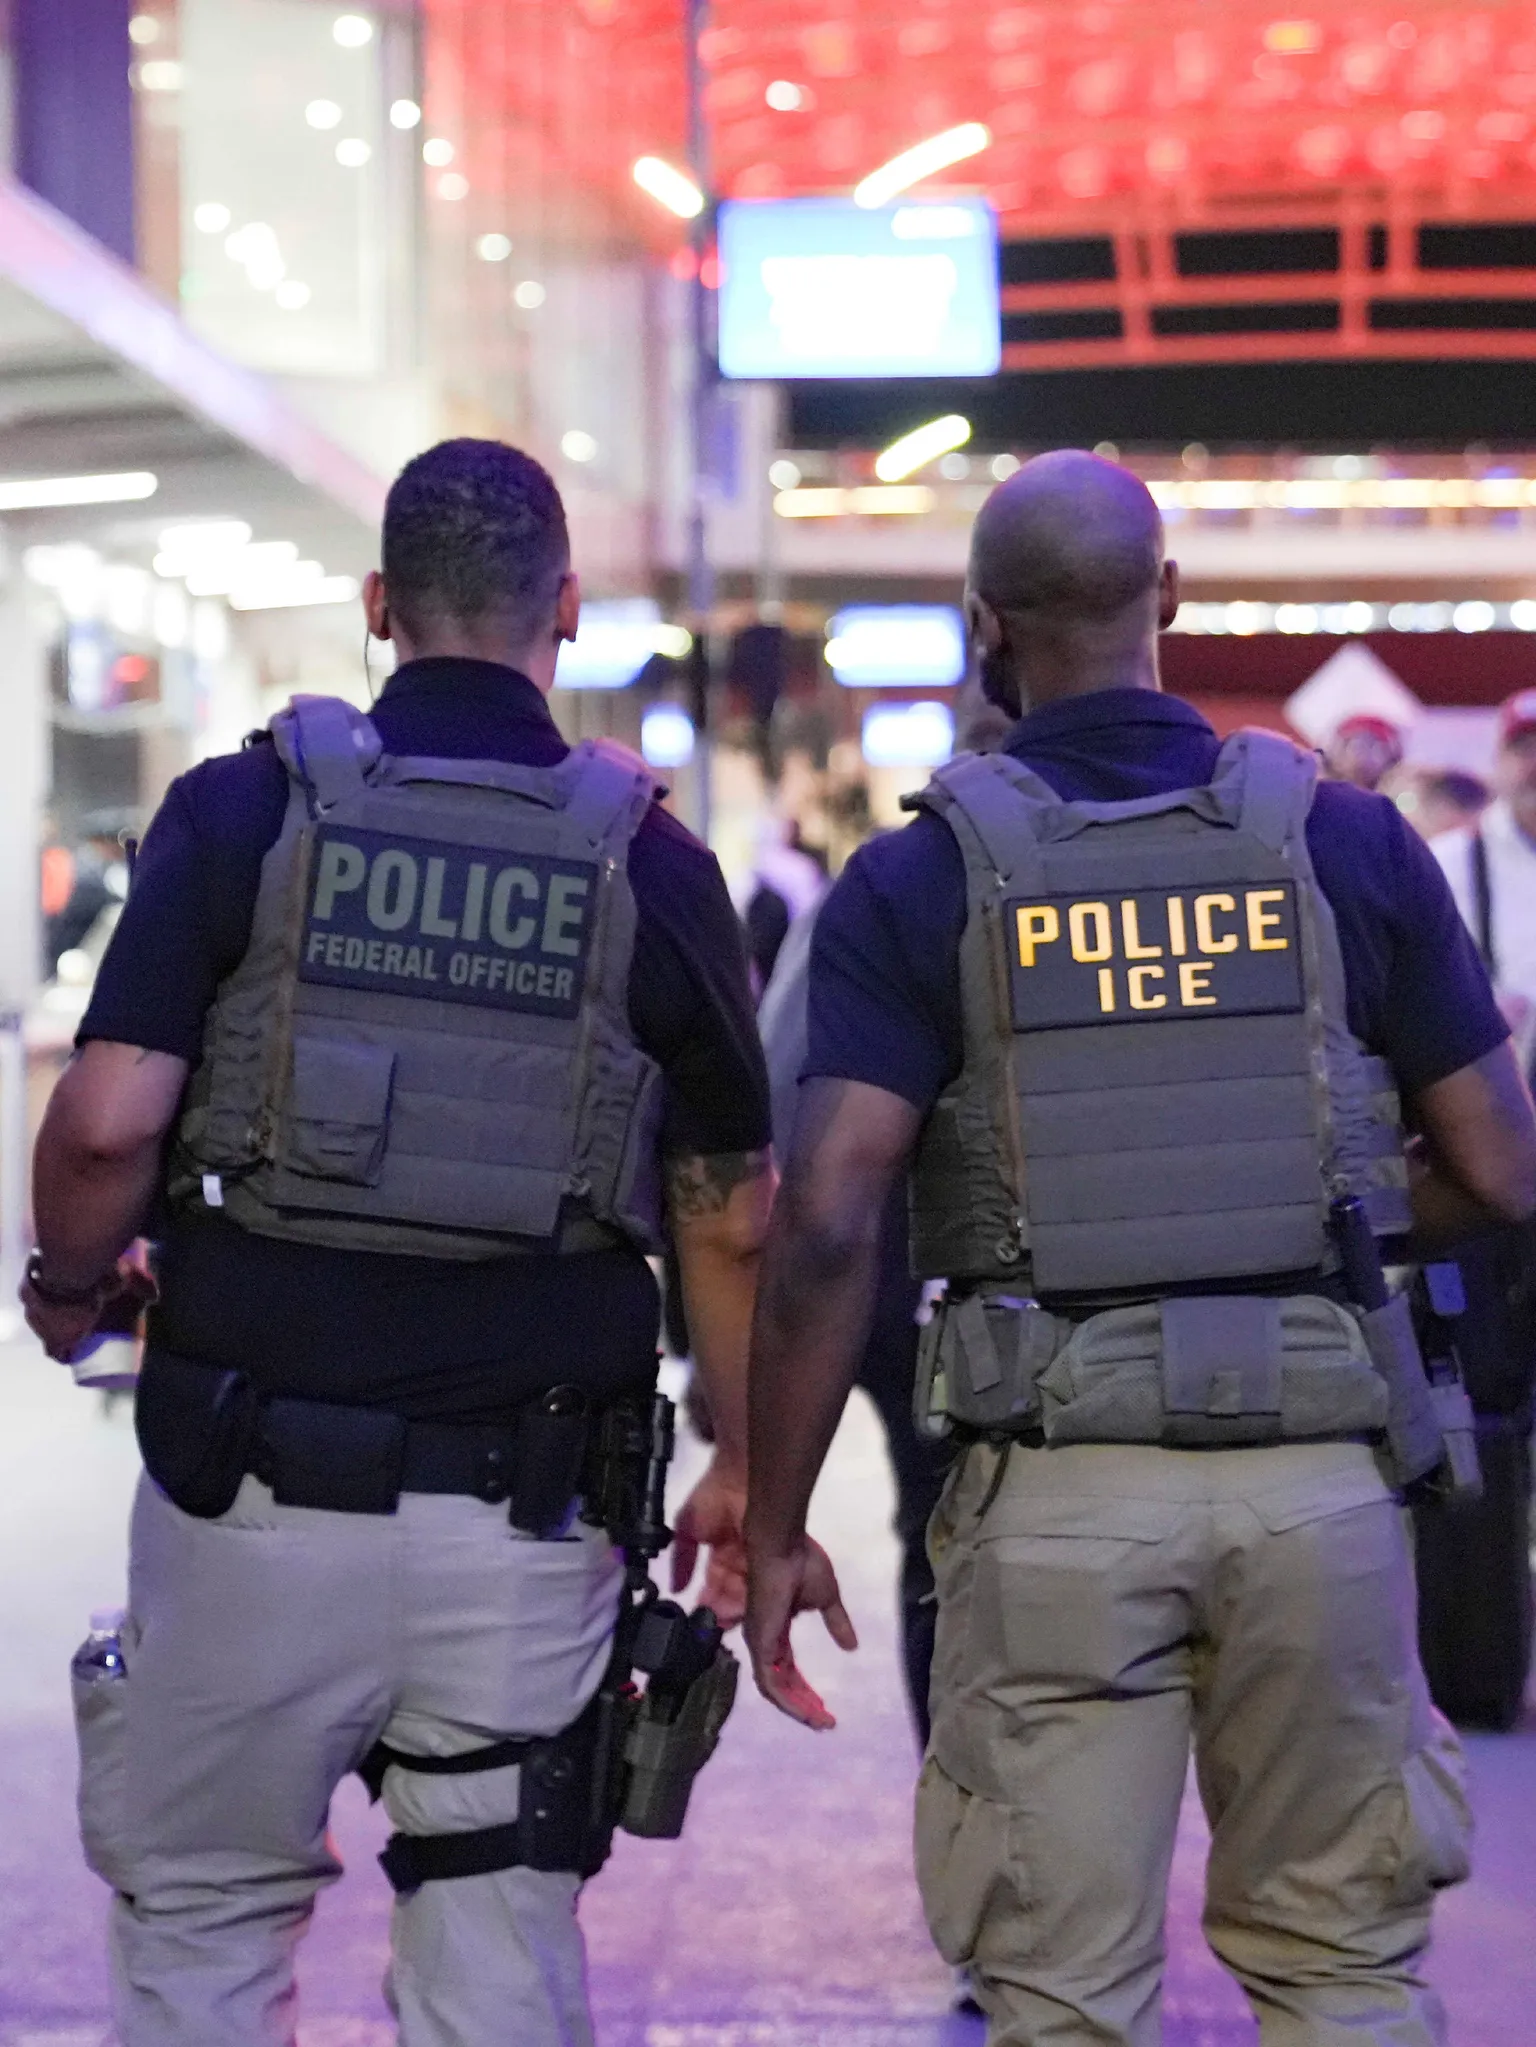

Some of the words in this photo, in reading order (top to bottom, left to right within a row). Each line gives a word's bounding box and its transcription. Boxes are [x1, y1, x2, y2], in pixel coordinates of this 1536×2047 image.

[313, 841, 589, 956] POLICE
[1016, 889, 1288, 967] POLICE
[306, 932, 437, 981] FEDERAL
[449, 952, 575, 1000] OFFICER
[1098, 961, 1217, 1013] ICE
